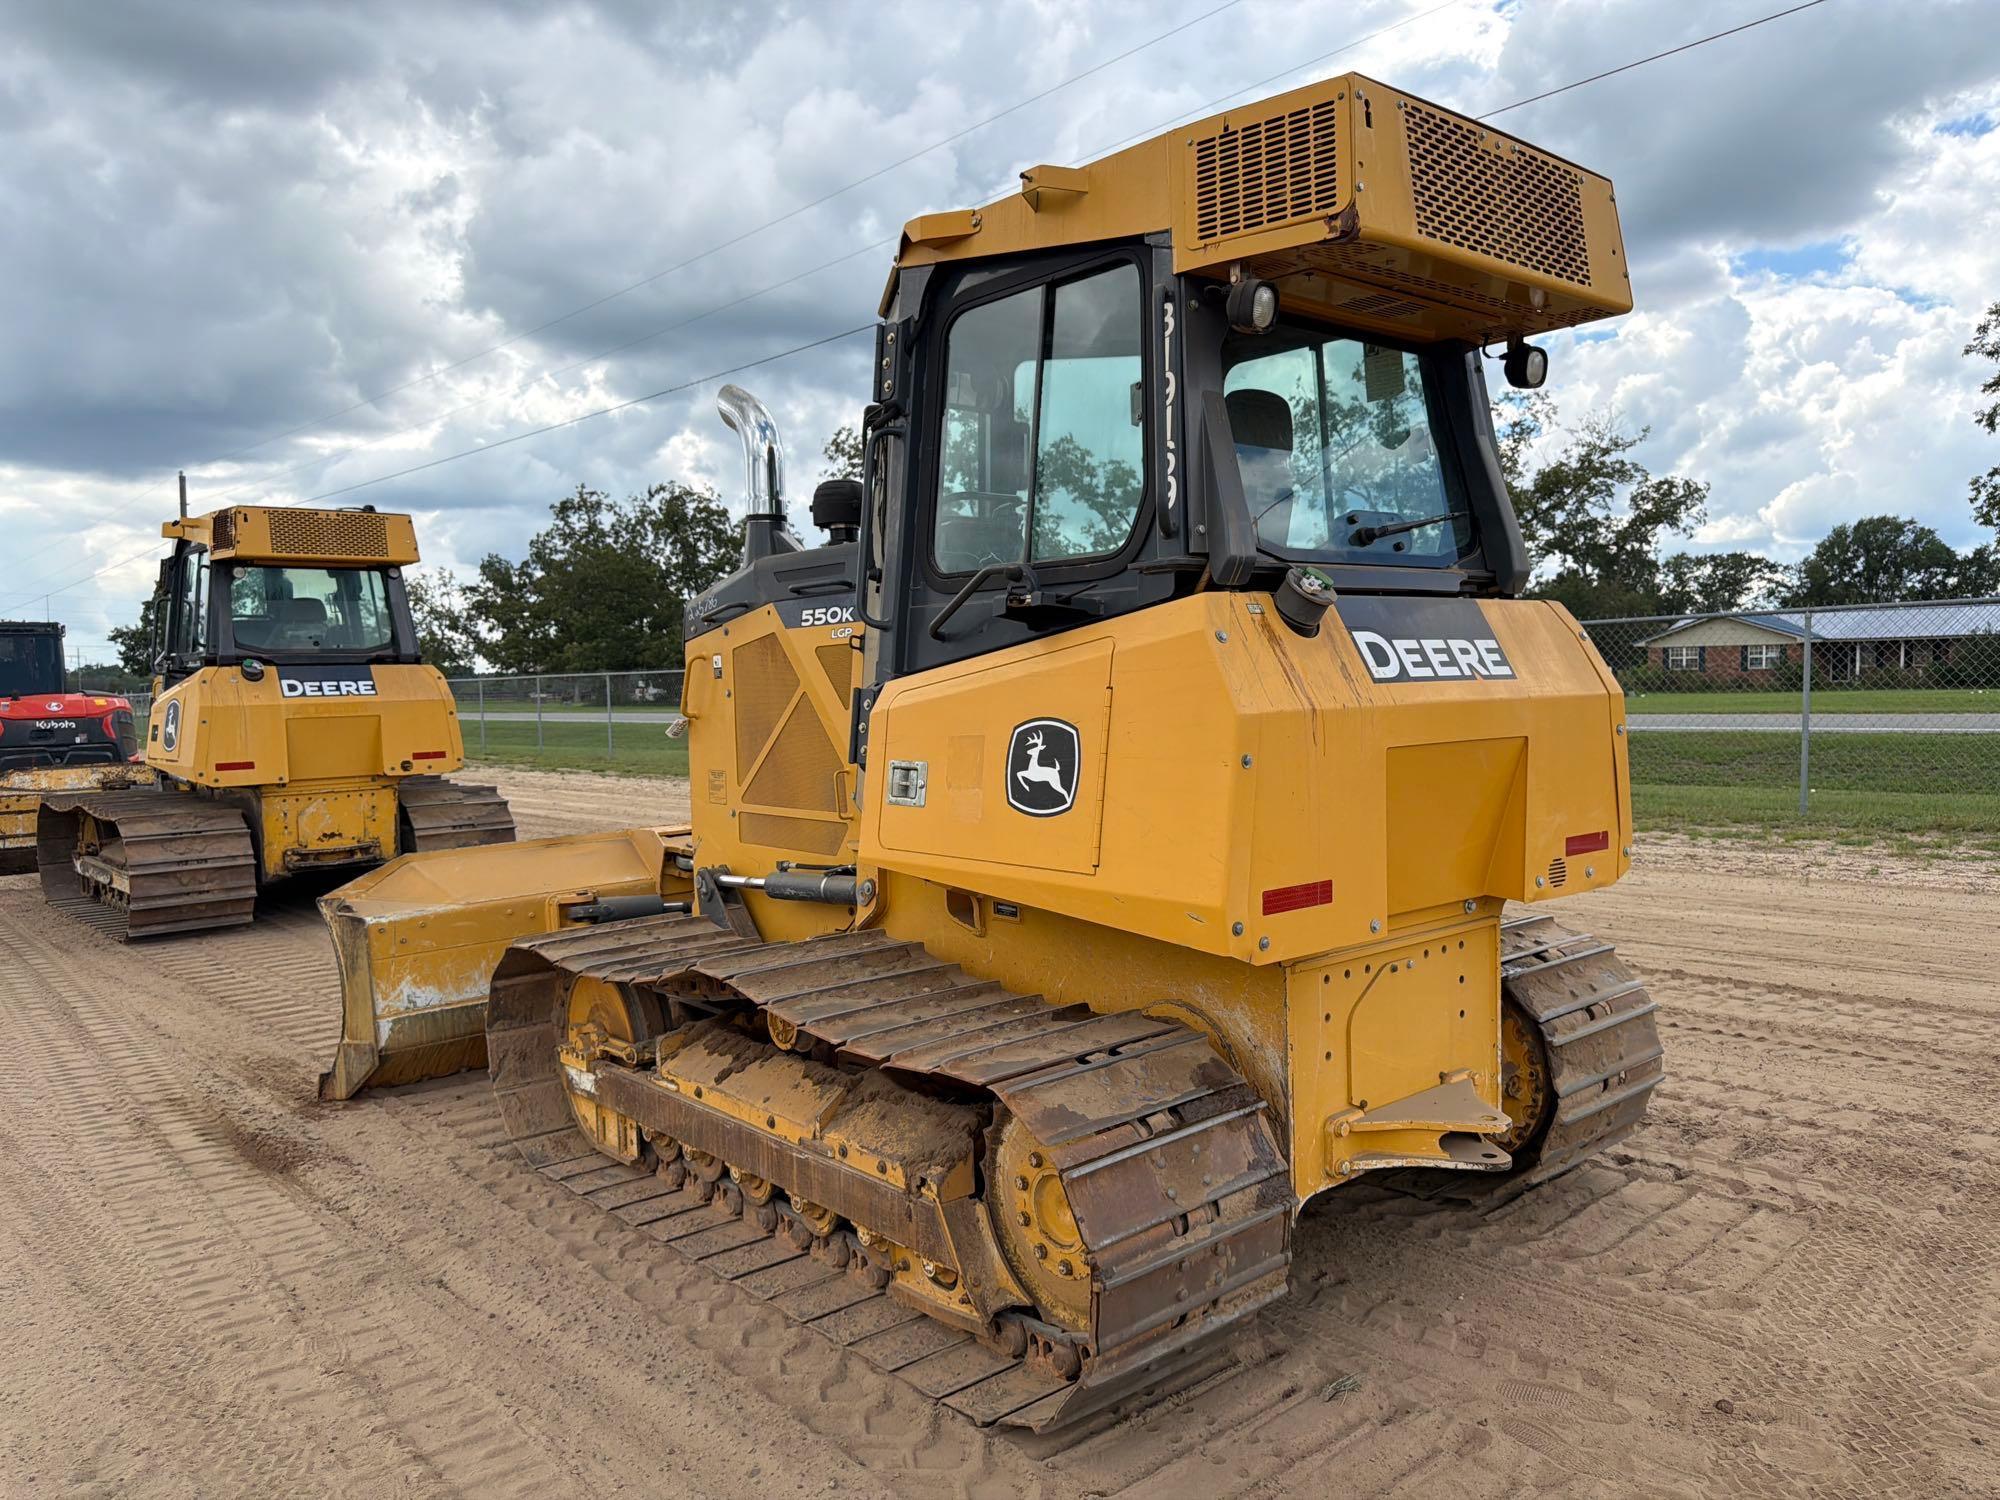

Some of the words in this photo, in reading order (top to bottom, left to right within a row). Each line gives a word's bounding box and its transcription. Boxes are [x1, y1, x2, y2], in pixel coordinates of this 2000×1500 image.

[801, 606, 854, 627] 550K
[831, 627, 853, 639] LGP
[1351, 630, 1513, 679] DEERE
[280, 679, 376, 697] DEERE
[35, 720, 76, 729] Kubota
